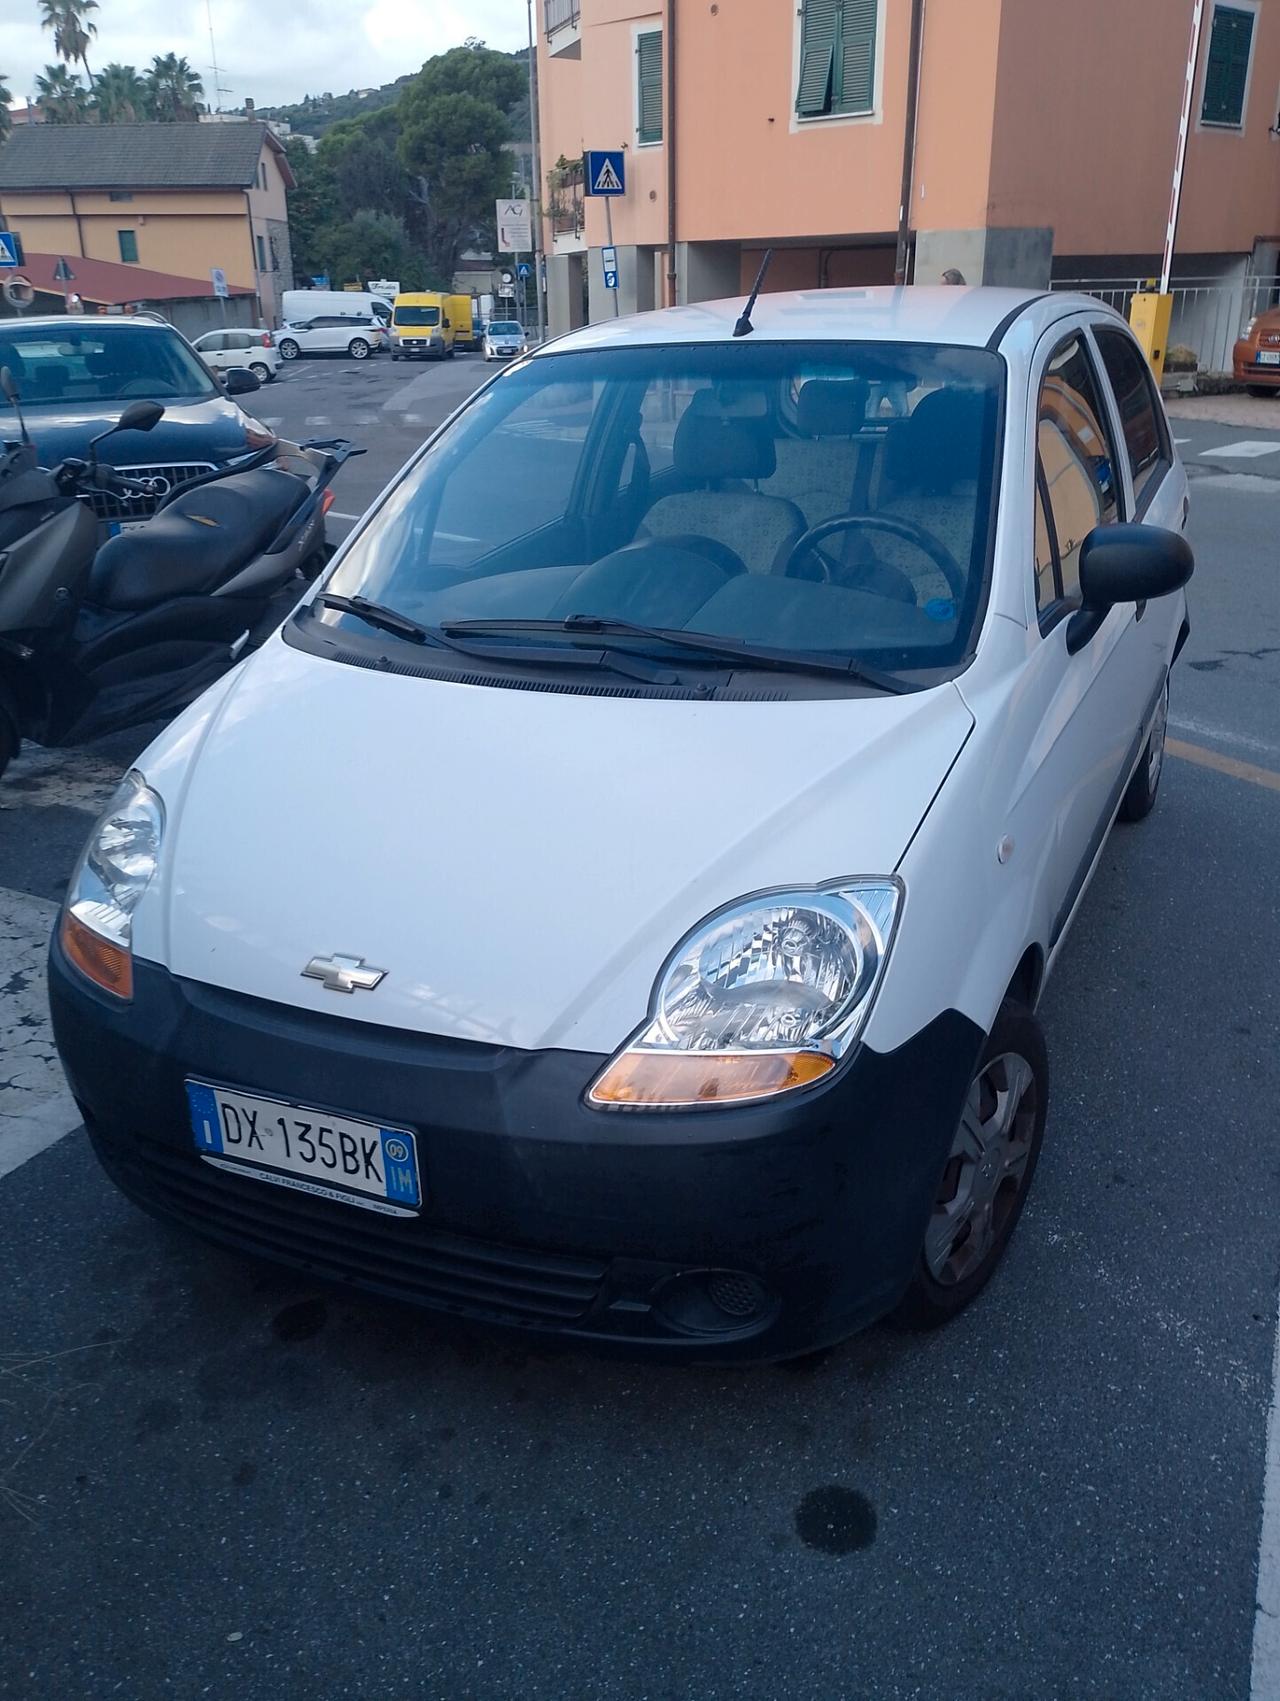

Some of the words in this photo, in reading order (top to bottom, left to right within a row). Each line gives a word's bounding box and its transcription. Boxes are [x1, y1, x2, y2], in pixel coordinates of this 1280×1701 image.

[203, 1120, 213, 1144] I
[220, 1103, 264, 1150] DX
[276, 1117, 383, 1183] 135BK
[389, 1143, 404, 1158] 09
[390, 1166, 413, 1194] IM
